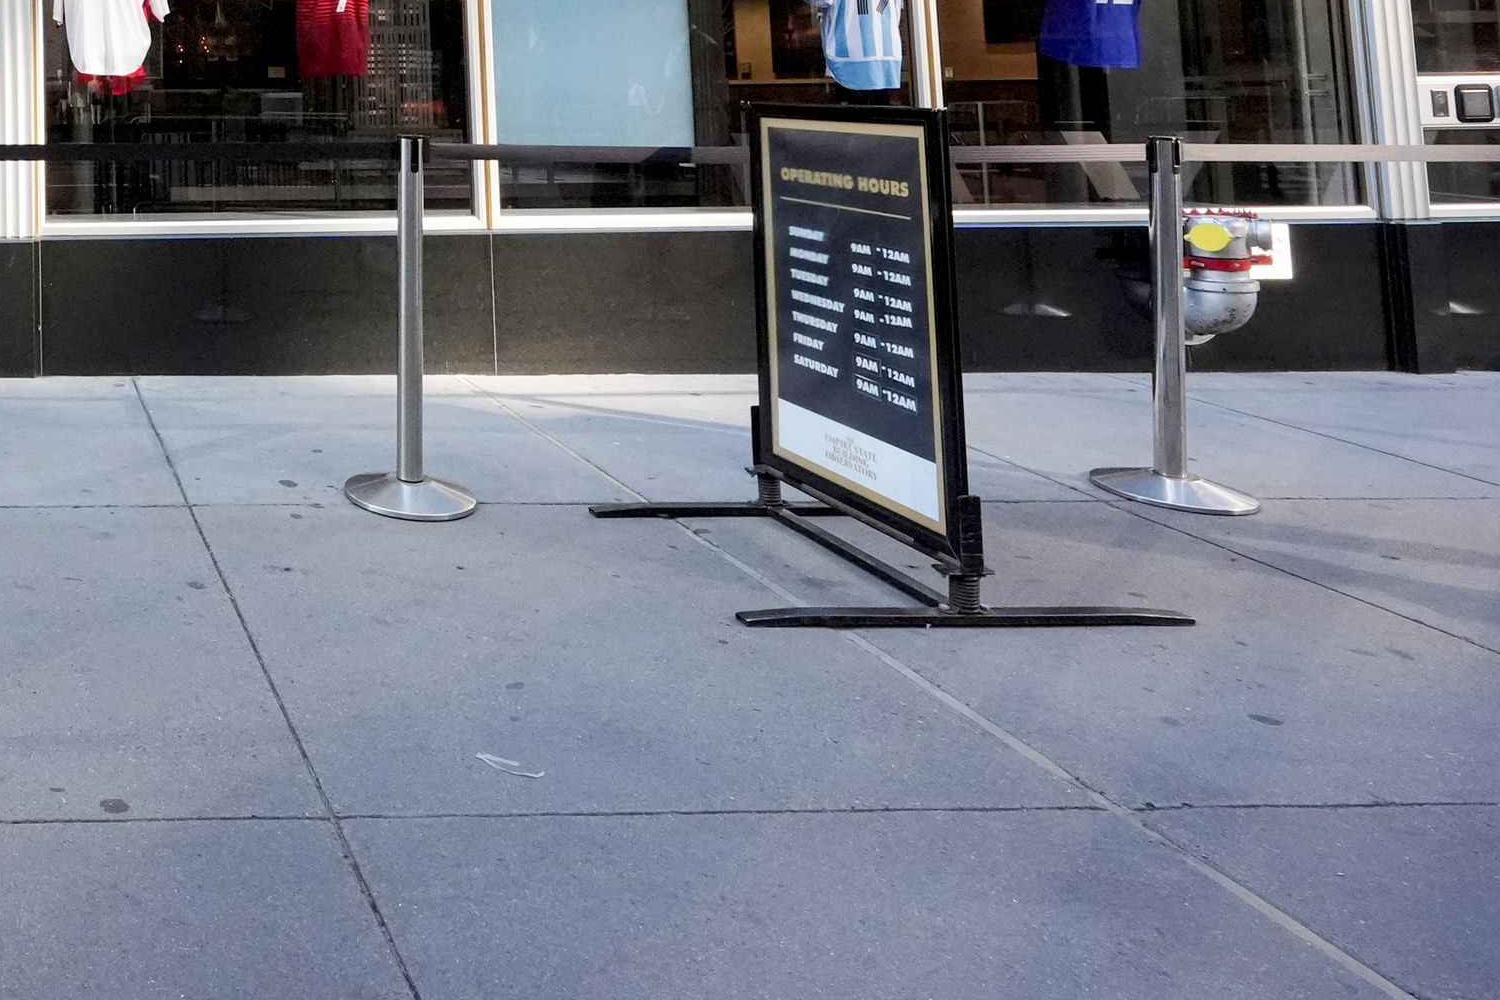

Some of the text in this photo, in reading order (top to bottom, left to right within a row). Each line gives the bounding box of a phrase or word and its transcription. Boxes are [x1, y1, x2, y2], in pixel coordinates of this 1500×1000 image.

[780, 167, 910, 198] OPERATING HOURS
[851, 243, 871, 255] 9AM
[790, 268, 829, 286] TUESDAY
[854, 288, 874, 302] 9AM
[852, 263, 872, 276] 9AM
[792, 310, 838, 333] THURSDAY
[854, 333, 876, 348] 9AM
[854, 309, 874, 323] 9AM
[793, 332, 824, 351] FRIDAY
[855, 357, 878, 373] 9AM
[794, 354, 839, 378] SATURDAY
[856, 379, 879, 396] 9AM
